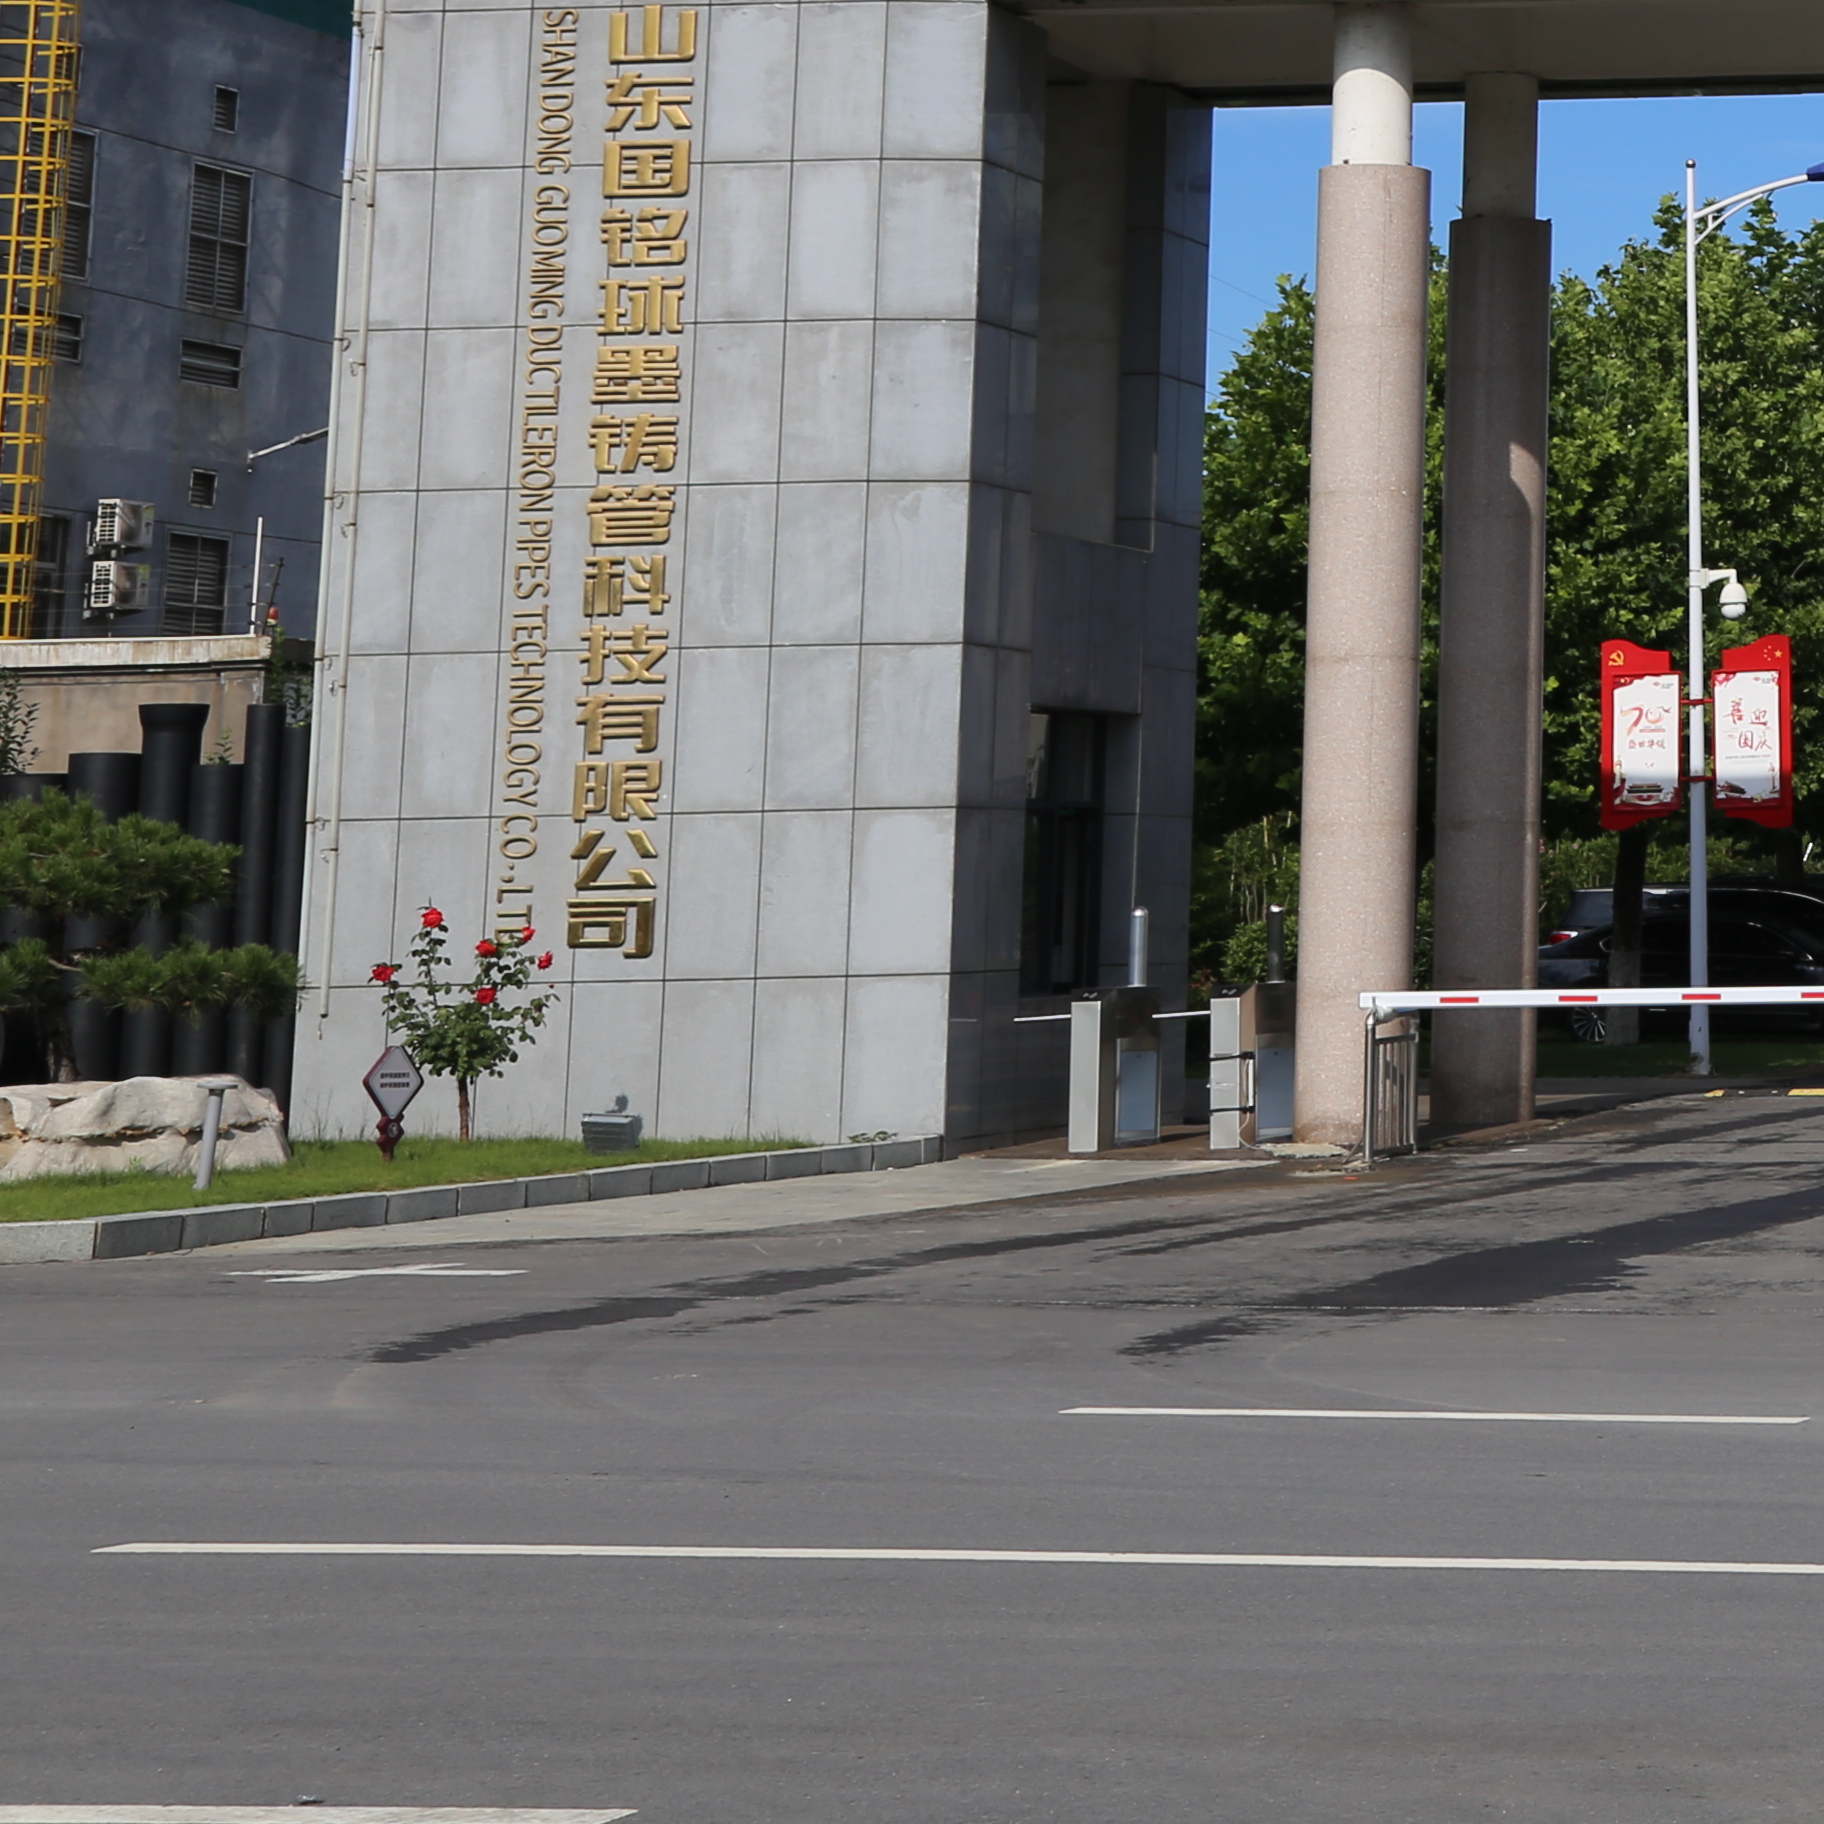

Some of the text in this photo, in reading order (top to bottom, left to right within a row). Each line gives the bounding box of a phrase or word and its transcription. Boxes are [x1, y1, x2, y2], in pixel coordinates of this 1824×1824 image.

[529, 184, 570, 318] GUOMING
[511, 518, 553, 600] PIPES
[566, 4, 698, 959] 山东国铭球墨铸管科技有限公司
[501, 603, 550, 808] TECHNOLOGY
